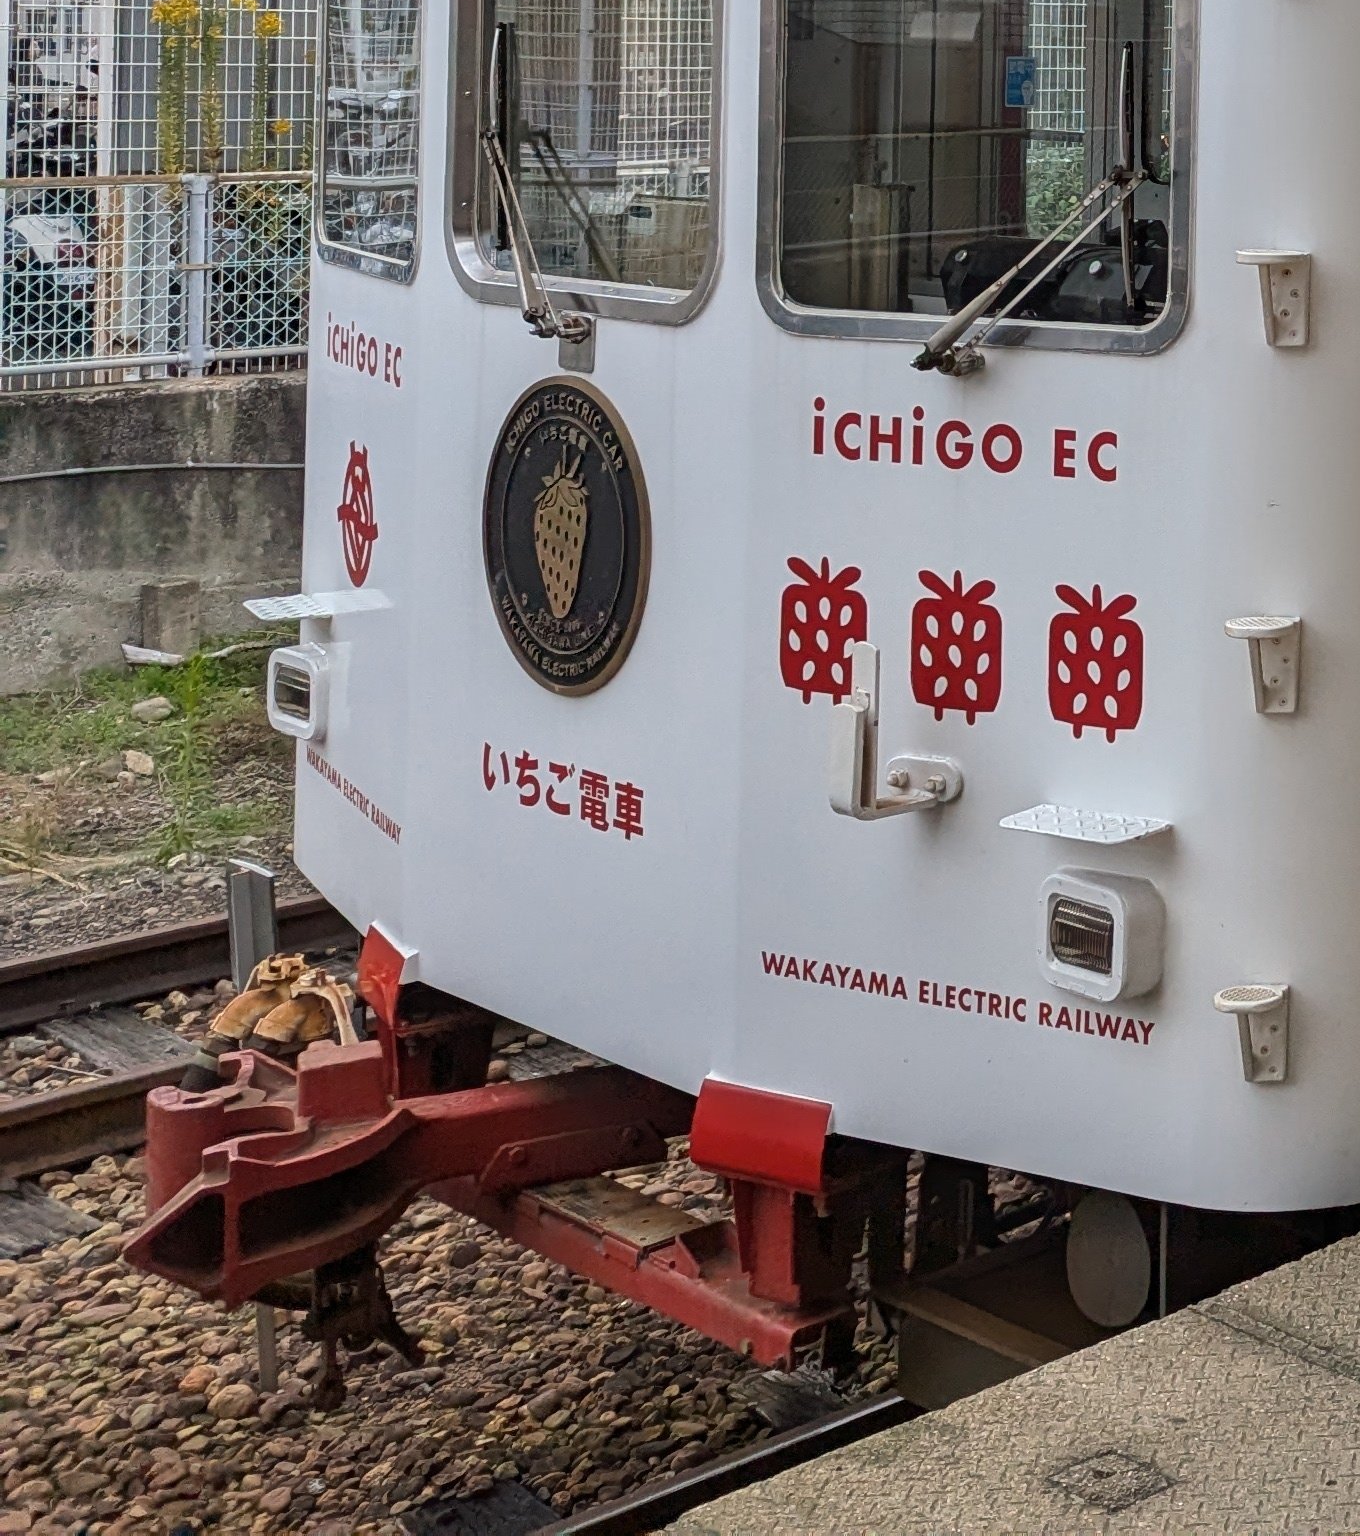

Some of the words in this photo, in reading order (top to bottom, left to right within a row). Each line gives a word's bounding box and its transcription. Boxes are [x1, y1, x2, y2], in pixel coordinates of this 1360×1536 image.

[384, 342, 402, 389] EC
[504, 400, 540, 455] ICHIGO
[543, 392, 601, 431] ELECTRIC
[602, 431, 623, 472] CAR
[1053, 429, 1119, 483] EC
[541, 655, 587, 677] ELECTRIC
[306, 744, 342, 793] WAKAYAMA
[343, 778, 370, 818] ELECTRIC
[371, 803, 401, 845] RAILWAY
[481, 740, 646, 840] いちご電車
[760, 950, 908, 1000] WAKAYAMA
[918, 979, 1027, 1022] ELECTRIC
[1037, 1002, 1156, 1046] RAILWAY
